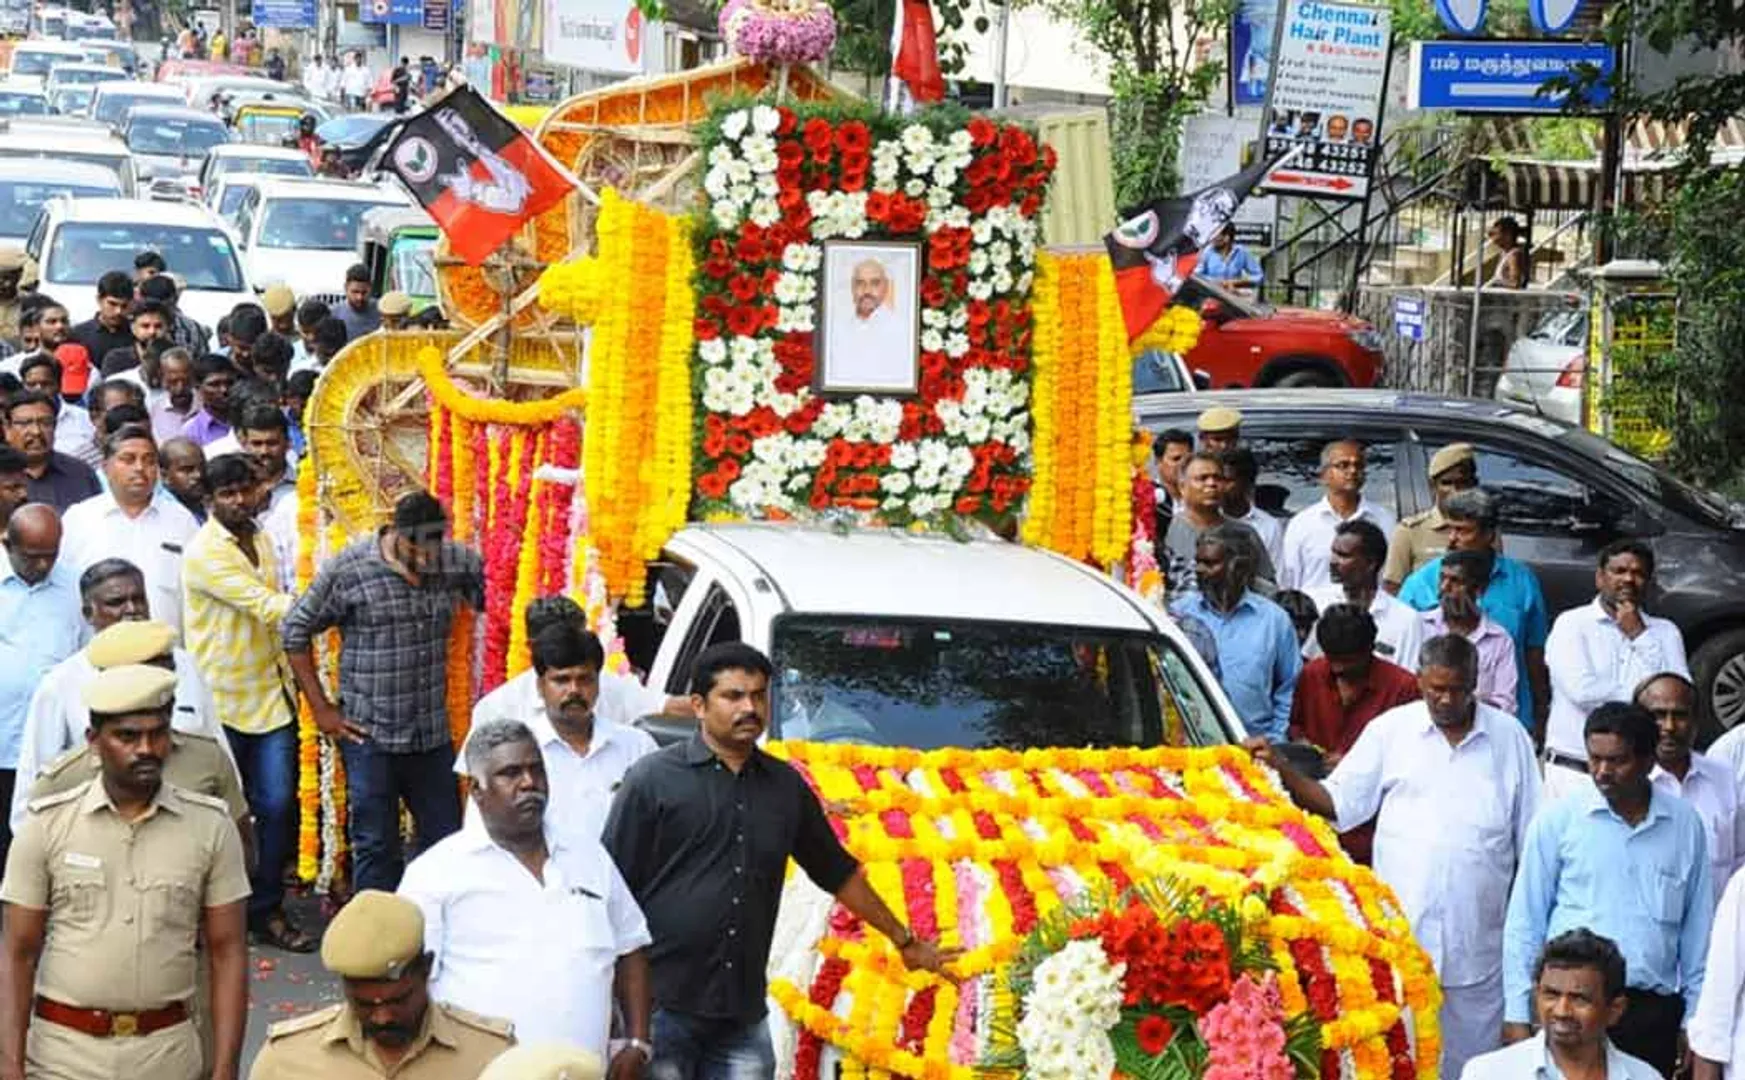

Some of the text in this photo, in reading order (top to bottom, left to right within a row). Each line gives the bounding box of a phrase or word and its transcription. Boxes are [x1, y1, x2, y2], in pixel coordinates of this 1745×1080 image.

[1290, 21, 1381, 47] Hair Plant
[1430, 52, 1460, 71] பல்
